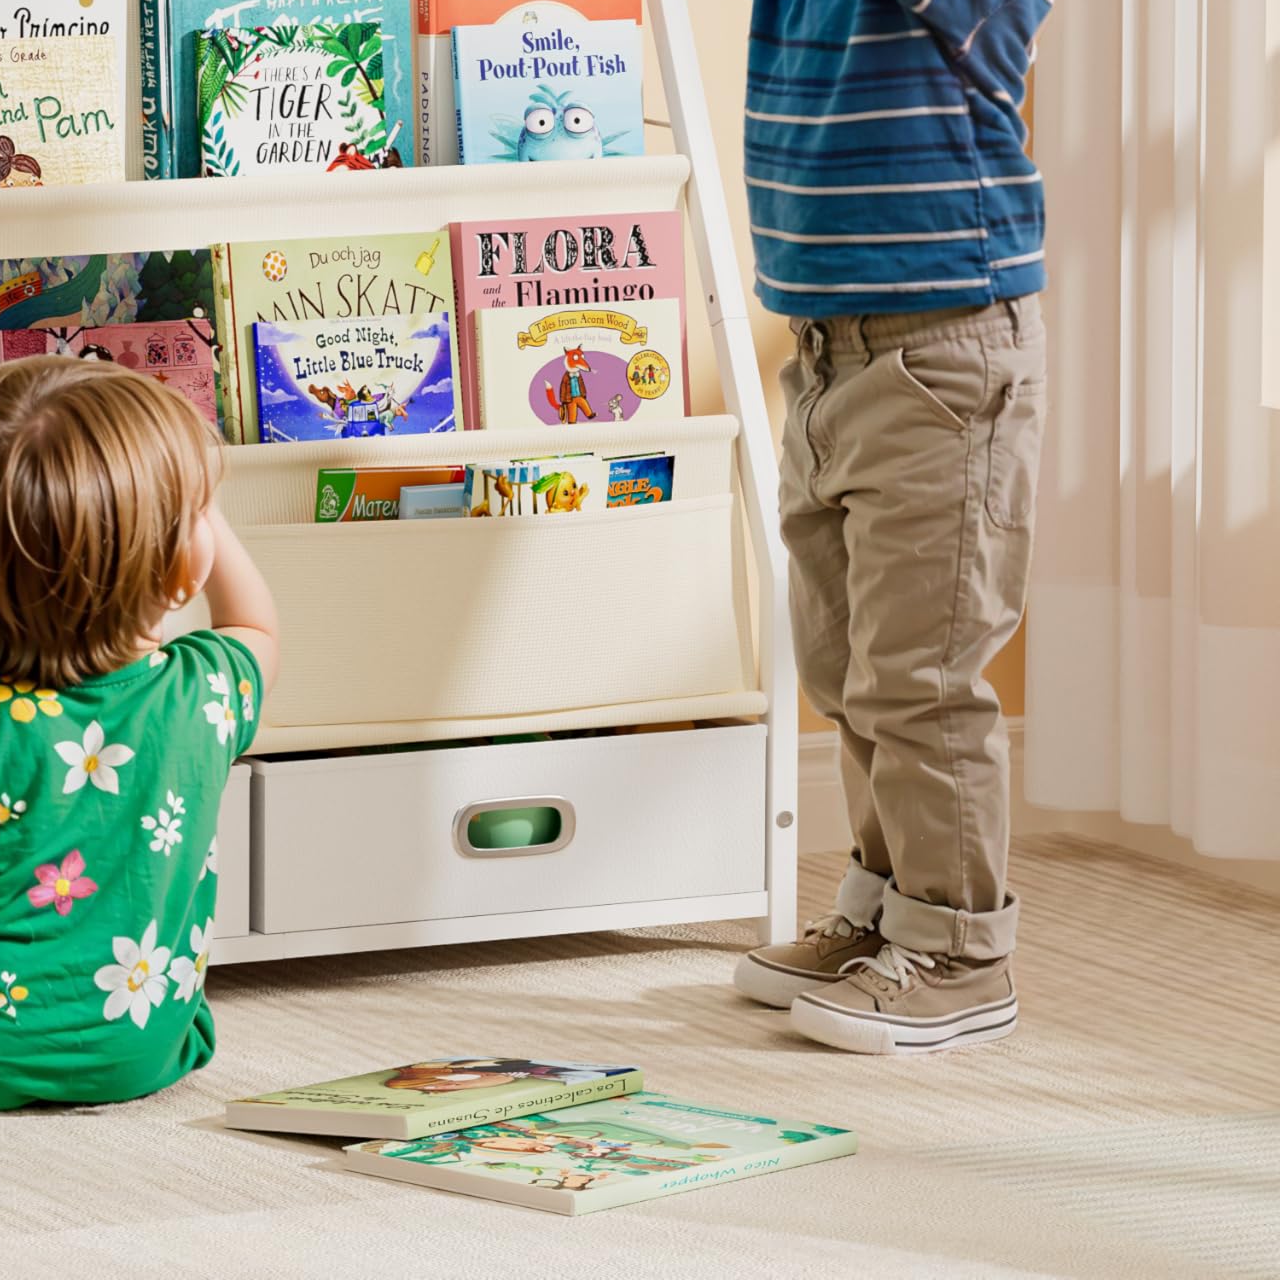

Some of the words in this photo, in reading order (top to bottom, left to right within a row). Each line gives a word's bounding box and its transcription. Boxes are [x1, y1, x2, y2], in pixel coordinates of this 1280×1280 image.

[522, 28, 581, 54] Smile,
[314, 66, 322, 80] A
[476, 55, 582, 81] Pout-Pout
[584, 54, 627, 77] Fish
[249, 83, 333, 121] TIGER
[33, 95, 114, 143] Pam
[269, 123, 280, 139] IN
[288, 122, 315, 138] THE
[256, 139, 332, 164] GARDEN
[309, 251, 328, 269] Du
[331, 246, 356, 262] och
[353, 246, 382, 269] jag
[476, 224, 657, 279] FLORA
[337, 273, 445, 318] SKATT
[483, 283, 502, 295] and
[491, 298, 507, 308] the
[515, 278, 655, 308] Flamingo
[535, 322, 556, 334] Tales
[558, 317, 578, 327] from
[580, 313, 604, 324] Acorn
[606, 314, 630, 330] Wood
[315, 328, 351, 349] Good
[355, 327, 398, 347] Night,
[293, 355, 337, 380] Little
[339, 350, 374, 372] Blue
[375, 348, 424, 373] Truck
[517, 1084, 594, 1109] calcetines
[596, 1078, 627, 1094] Los
[427, 1108, 490, 1129] Susana
[494, 1105, 514, 1118] de
[744, 1156, 781, 1171] Nico
[658, 1166, 736, 1191] Whopper
